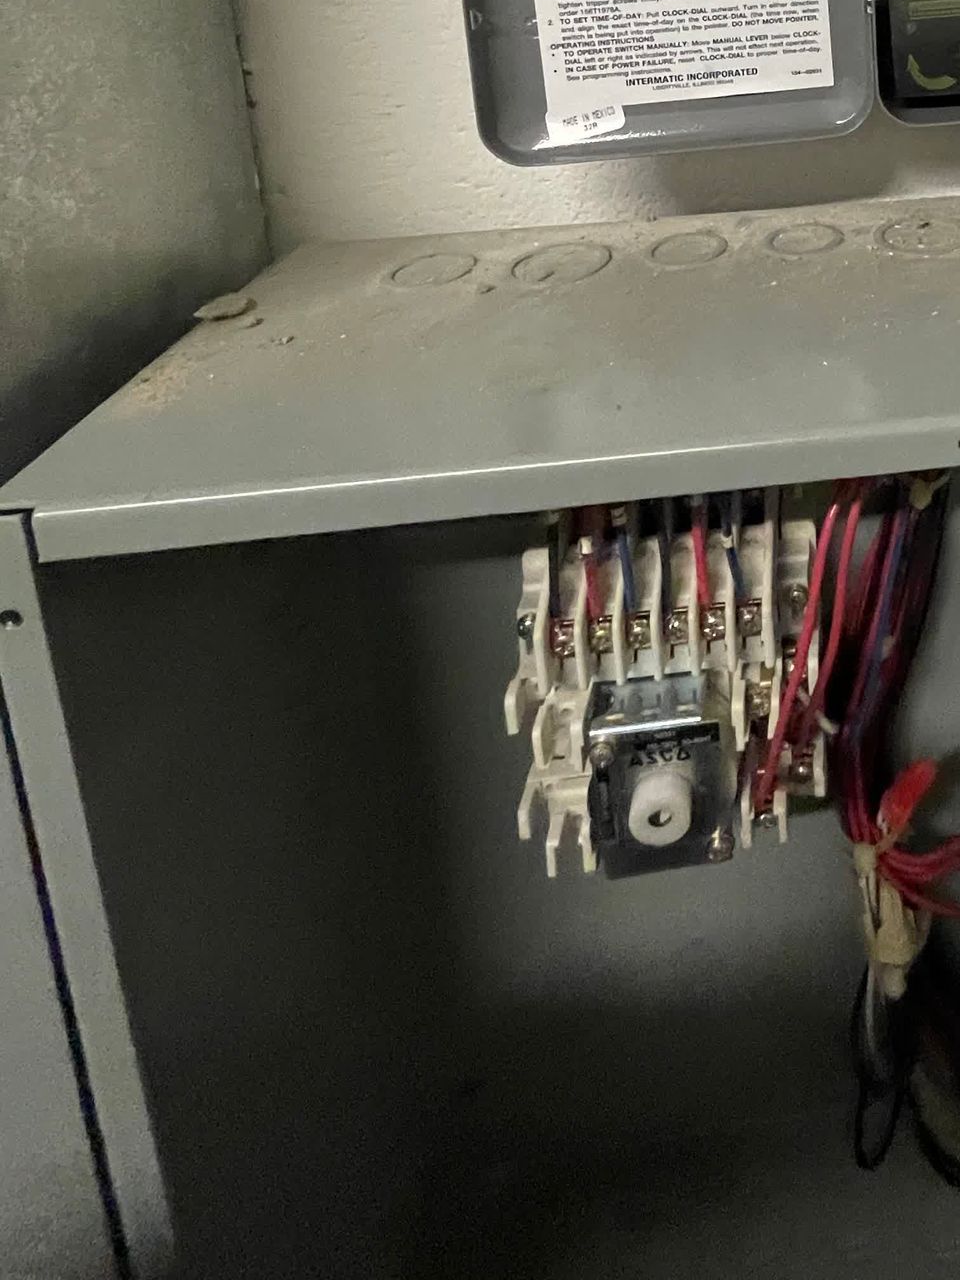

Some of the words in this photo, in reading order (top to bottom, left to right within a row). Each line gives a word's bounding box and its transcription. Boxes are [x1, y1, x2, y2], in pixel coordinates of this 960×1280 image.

[559, 17, 571, 25] TO
[572, 16, 588, 24] SET
[661, 6, 707, 17] CLOCK-DIAL
[701, 11, 747, 22] CLOCK-DIAL
[761, 17, 783, 25] MOVE
[549, 39, 596, 50] OPERATING
[597, 34, 654, 46] INSTRUCTIONS
[576, 46, 612, 56] OPERATE
[614, 44, 644, 53] SWITCH
[712, 36, 742, 45] MANUAL
[745, 33, 768, 42] LEVER
[563, 57, 582, 65] DIAL
[575, 64, 597, 72] CASE
[611, 60, 640, 69] POWER
[641, 57, 675, 67] FAILURE,
[699, 51, 745, 62] CLOCK-DIAL
[625, 74, 683, 86] INTERMATIC
[686, 67, 758, 81] INCORPORATED
[629, 749, 692, 767] ASCO
